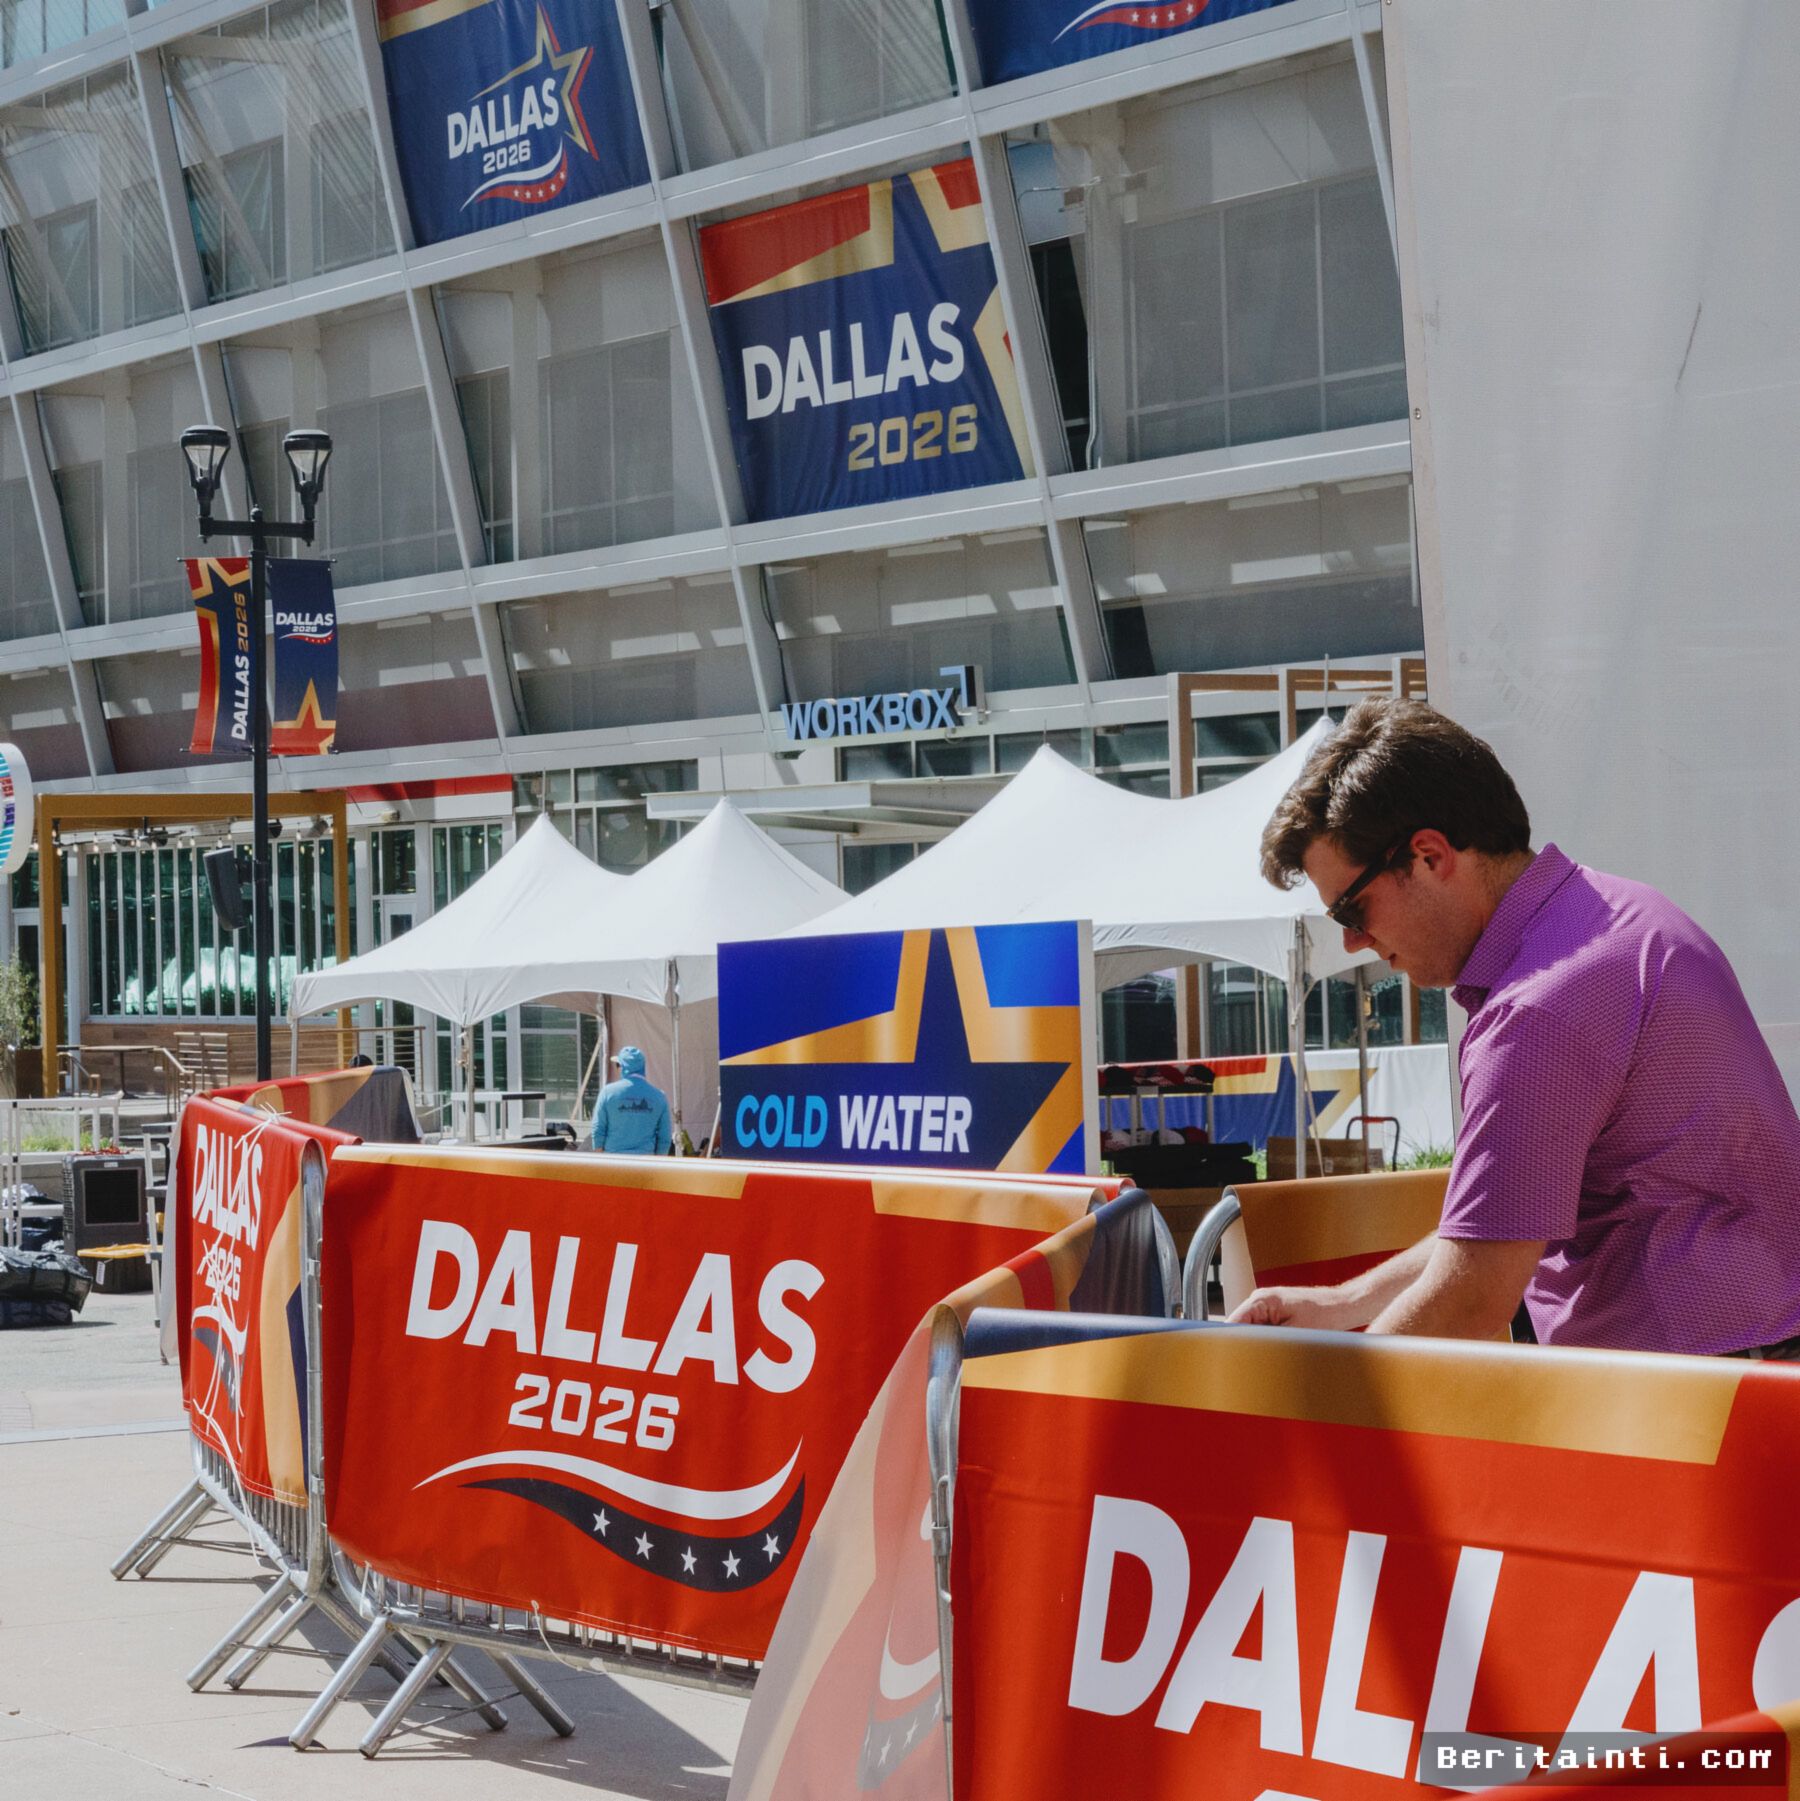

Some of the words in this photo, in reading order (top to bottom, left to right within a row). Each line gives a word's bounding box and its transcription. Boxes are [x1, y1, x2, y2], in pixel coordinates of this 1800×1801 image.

[447, 77, 560, 160] DALLAS
[482, 139, 532, 175] 2026
[742, 302, 965, 420] DALLAS
[848, 403, 979, 472] 2026
[234, 591, 249, 653] 2026
[275, 612, 334, 626] DALLAS
[292, 625, 318, 633] 2026
[231, 655, 250, 741] DALLAS
[780, 687, 958, 741] WORKBOX
[735, 1094, 829, 1149] COLD
[839, 1095, 973, 1153] WATER
[192, 1123, 263, 1252] DALLAS
[405, 1219, 826, 1394] DALLAS
[507, 1372, 681, 1452] 2026
